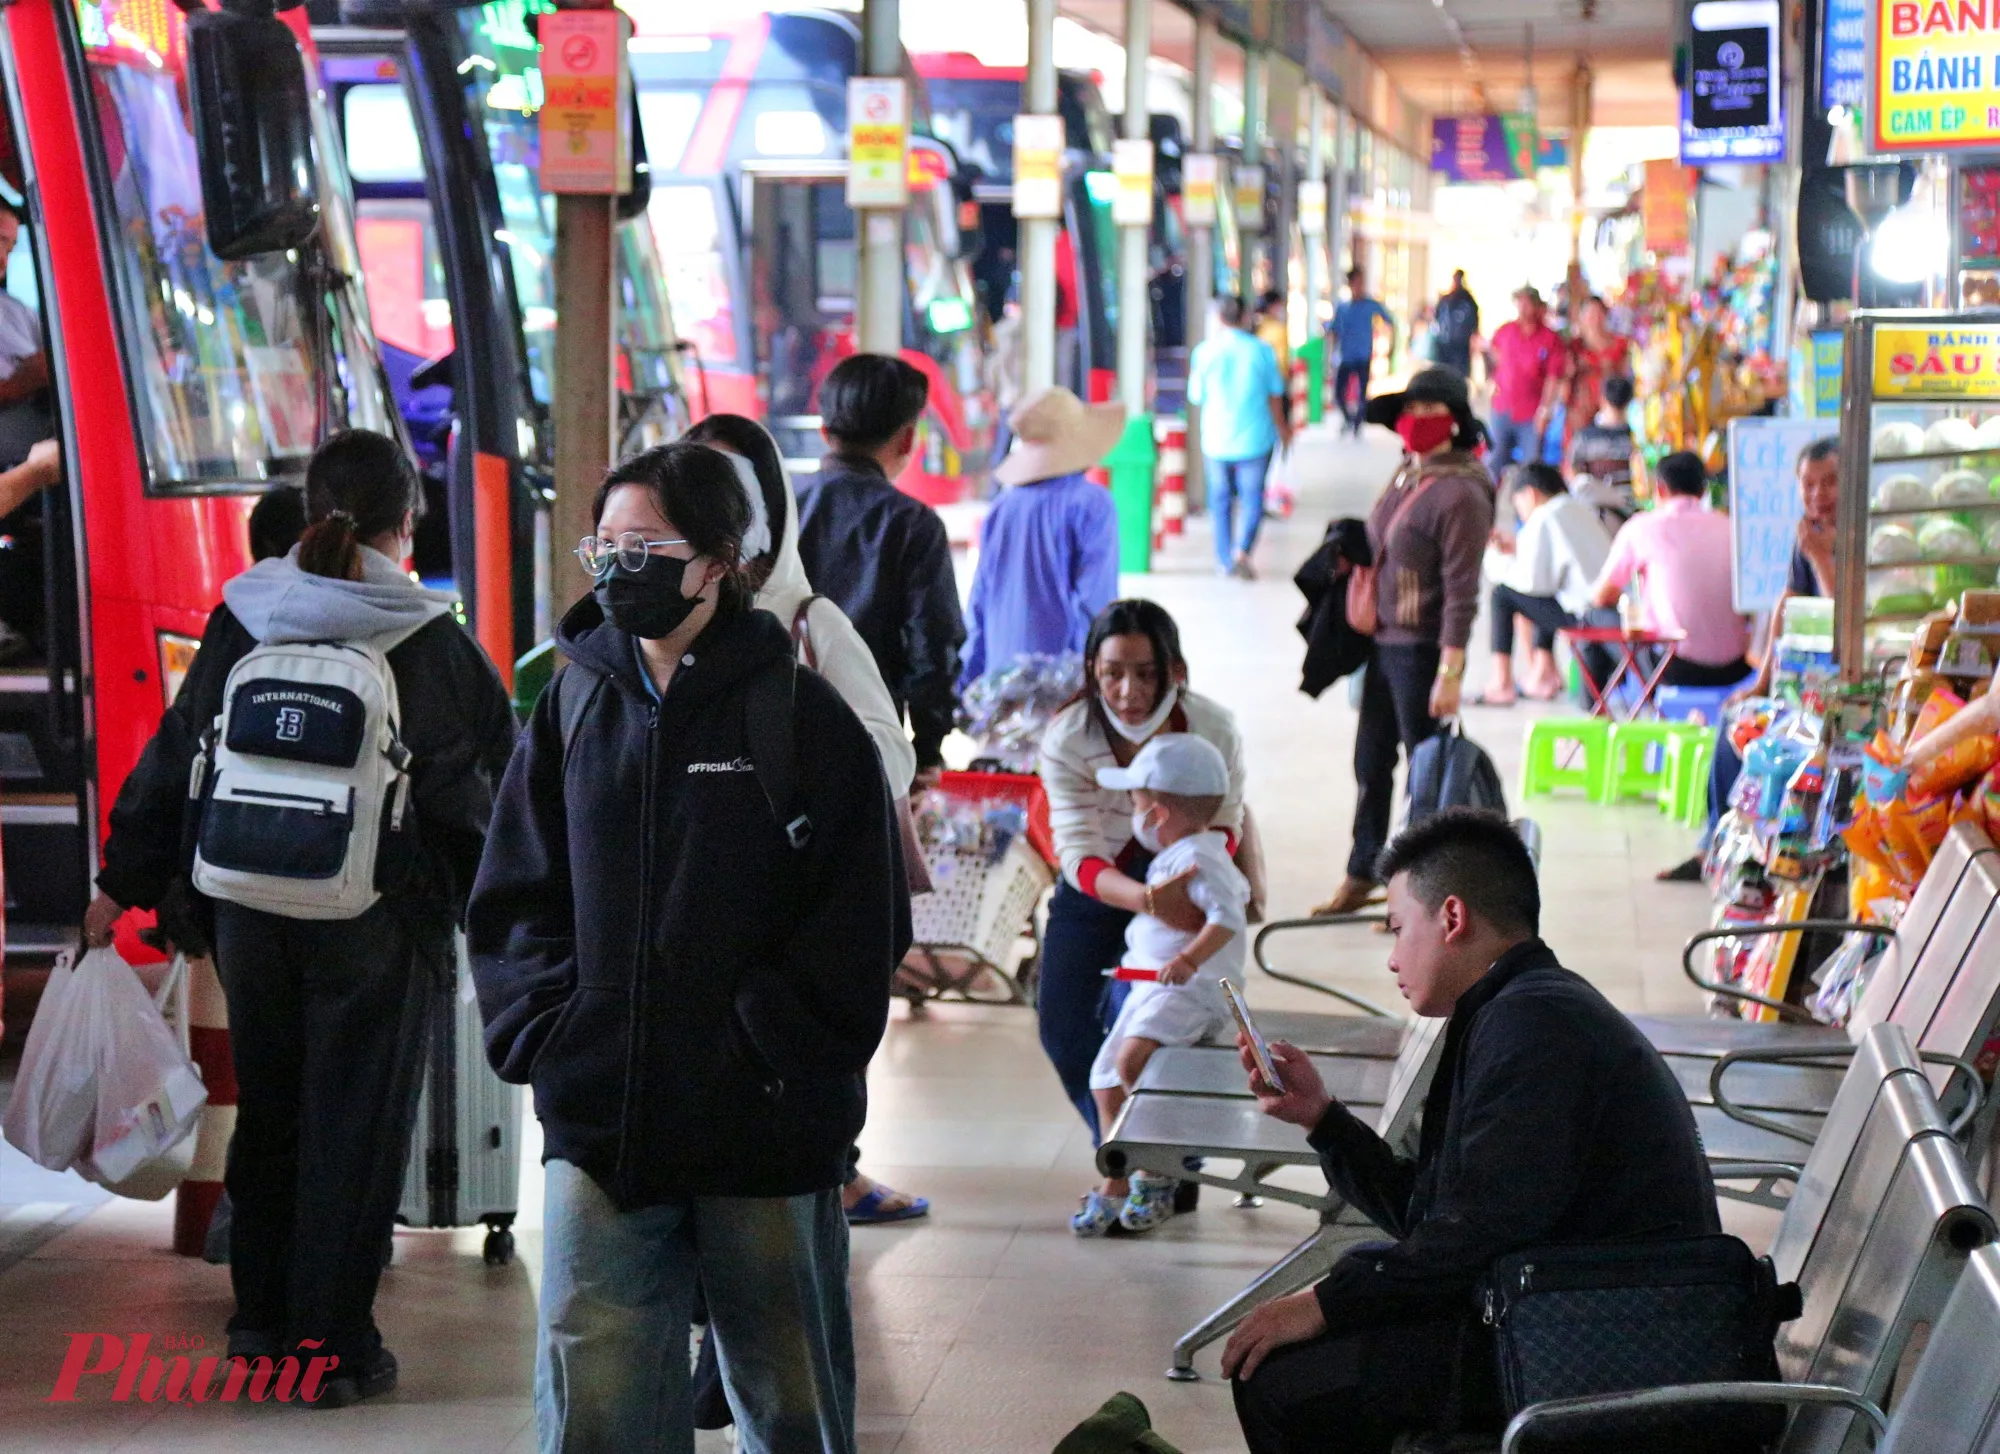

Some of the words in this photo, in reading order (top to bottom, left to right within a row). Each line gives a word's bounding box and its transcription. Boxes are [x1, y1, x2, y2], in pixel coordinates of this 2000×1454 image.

[1891, 110, 1933, 135] CAM
[252, 692, 342, 713] INTERNATIONAL
[276, 707, 305, 742] B
[687, 762, 733, 773] OFFICIAL
